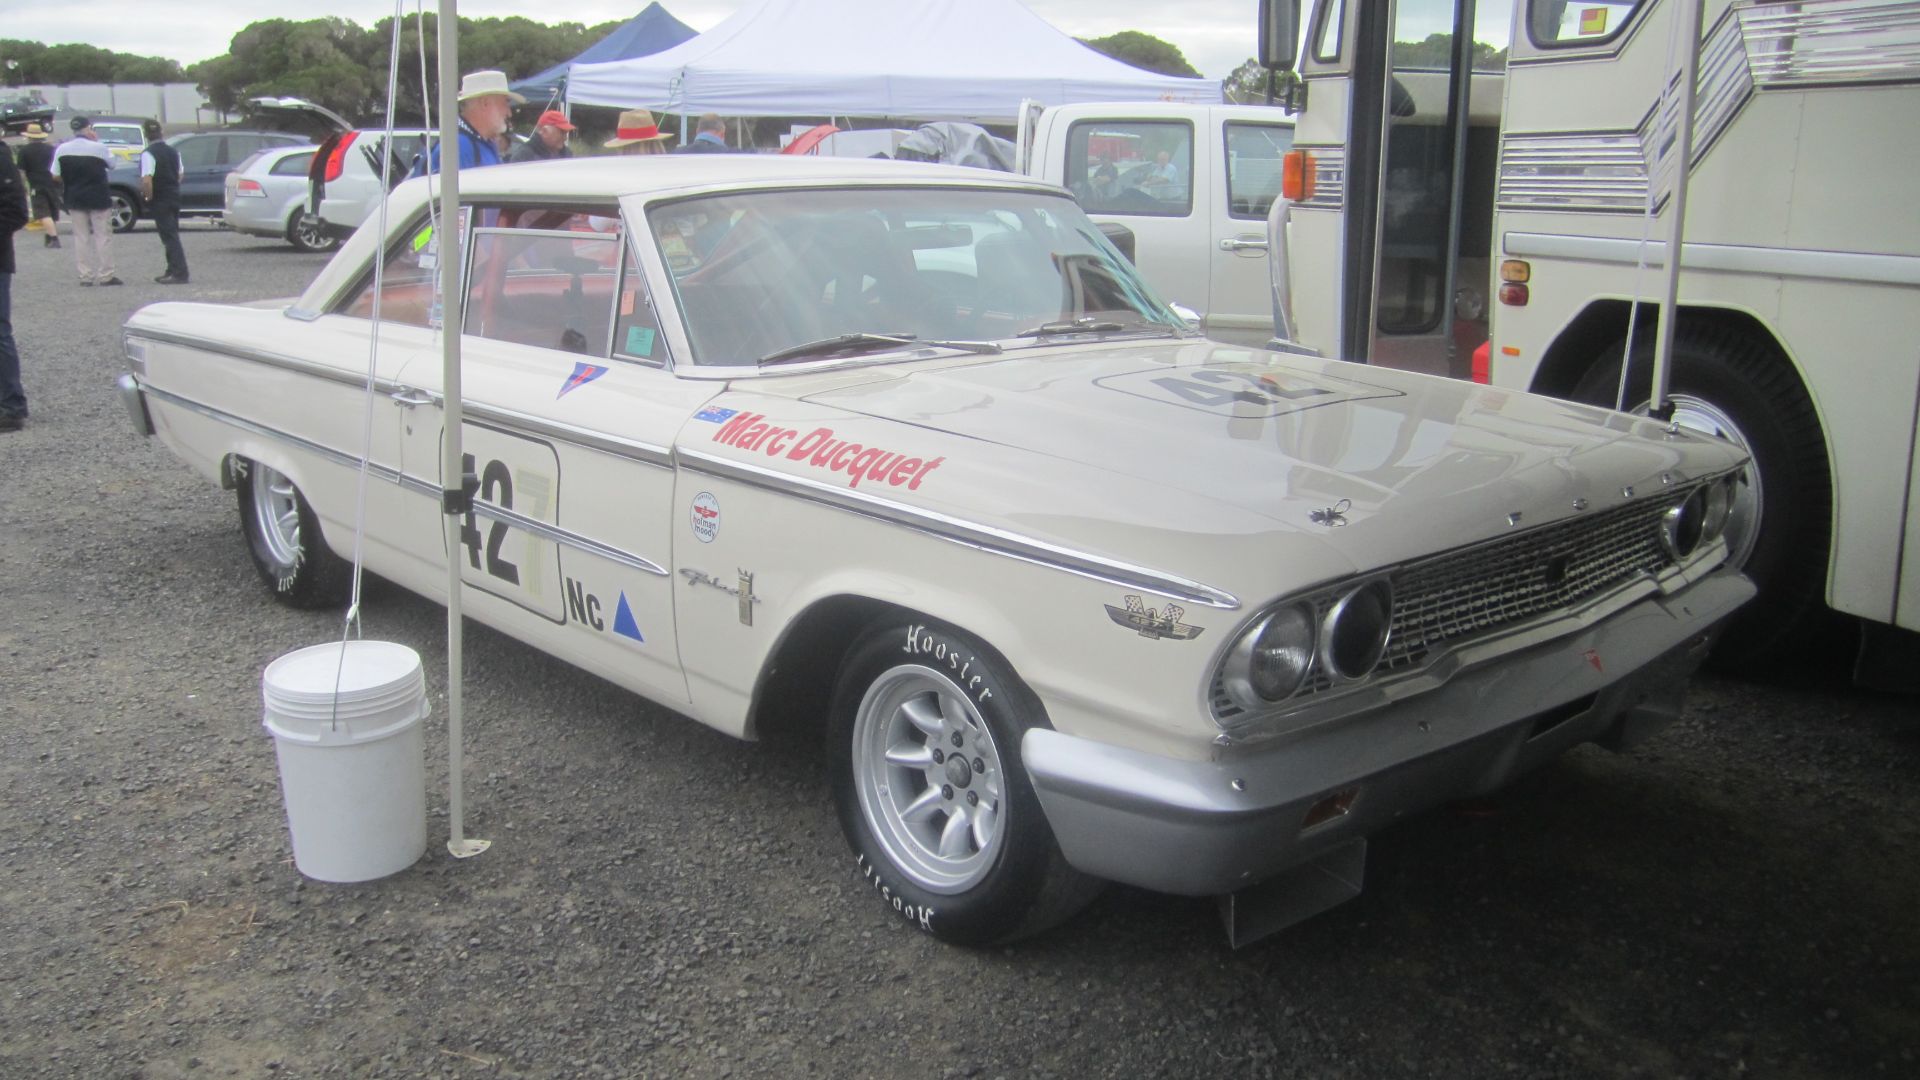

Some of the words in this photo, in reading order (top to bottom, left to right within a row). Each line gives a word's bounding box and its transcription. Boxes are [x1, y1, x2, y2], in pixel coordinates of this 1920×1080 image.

[712, 411, 798, 456] Marc
[786, 427, 946, 491] Ducquet
[693, 514, 717, 530] holman
[695, 524, 715, 537] moody
[903, 624, 993, 702] Hoosier
